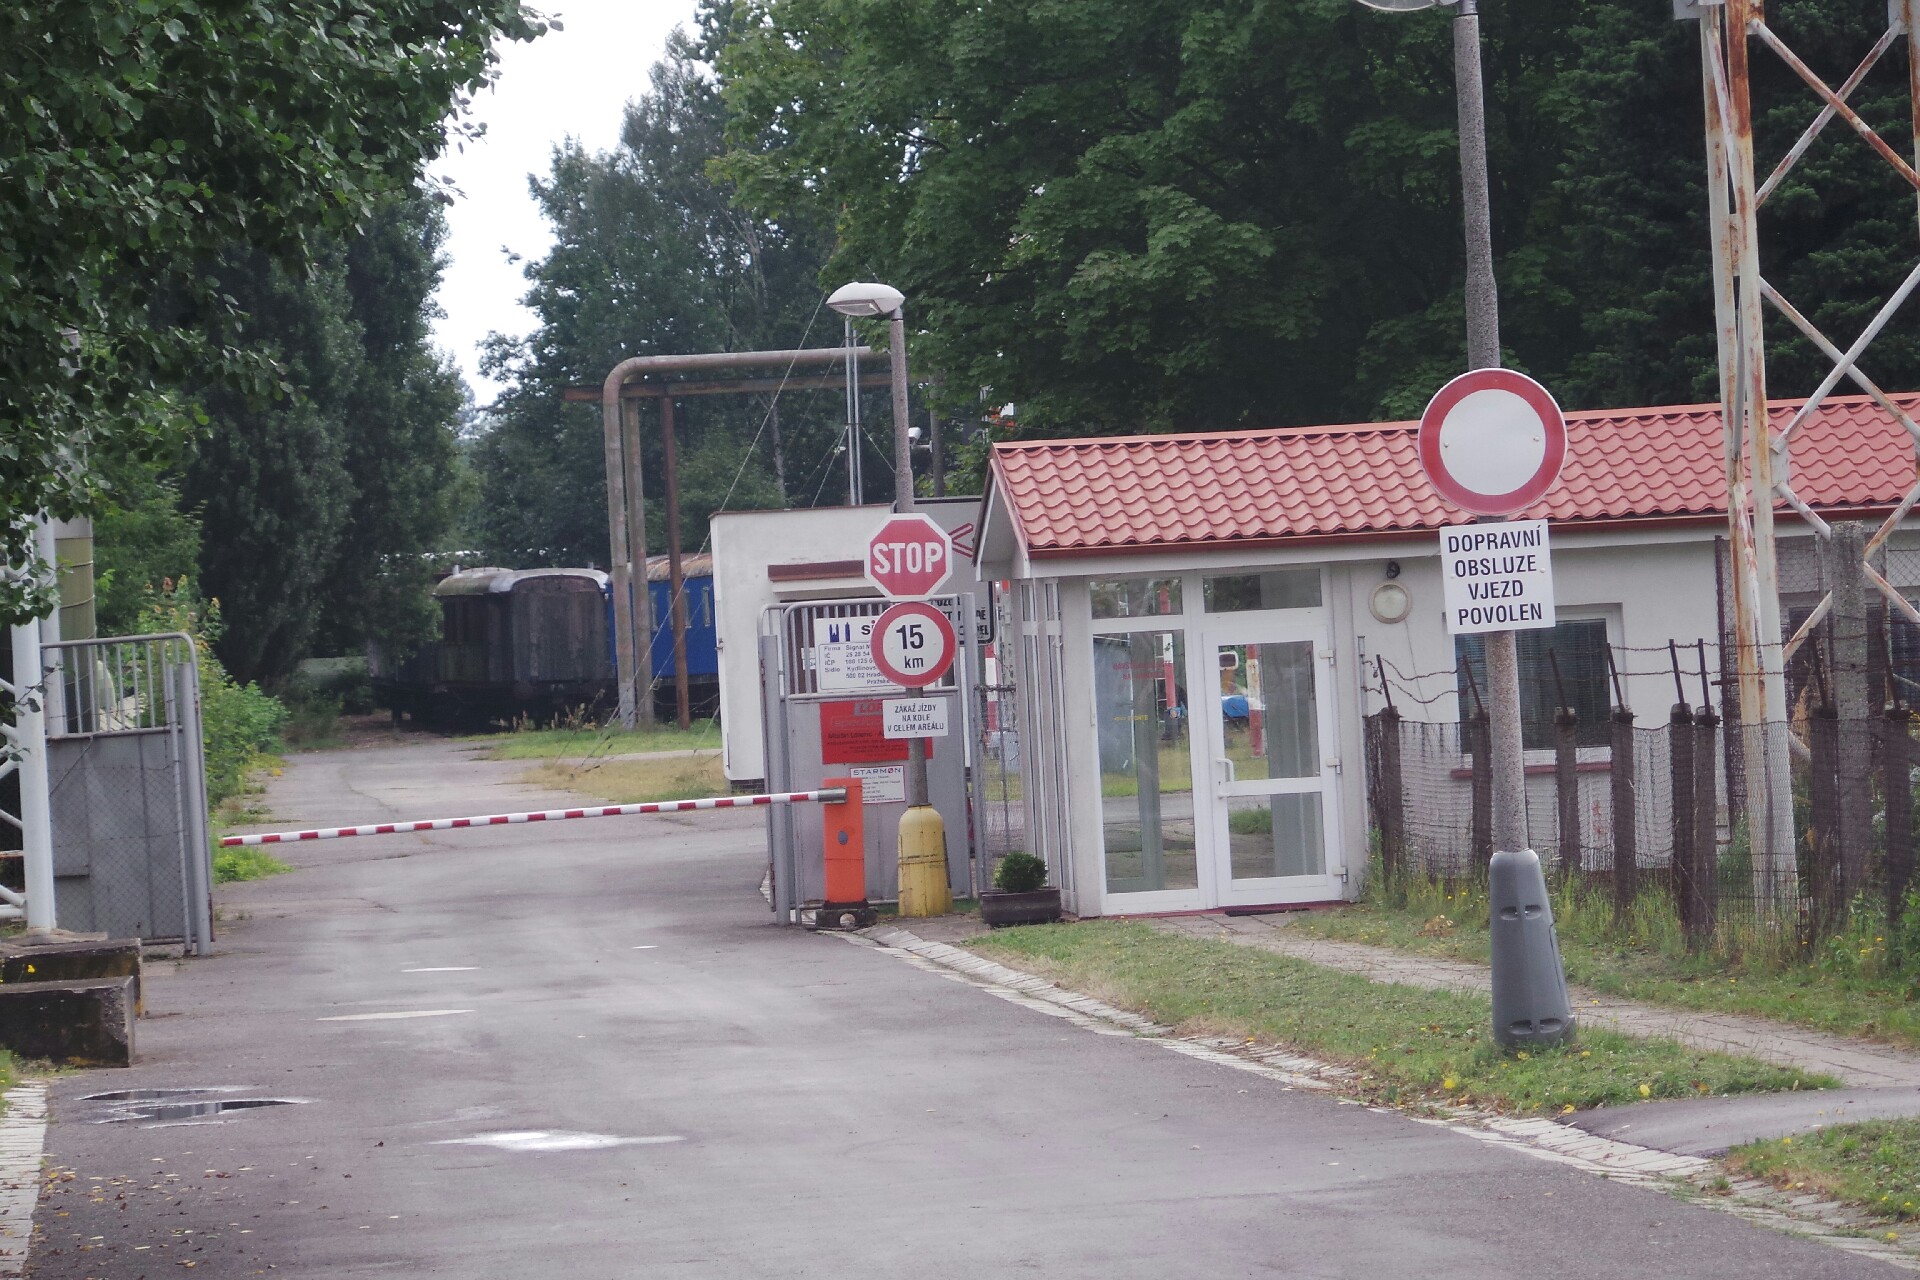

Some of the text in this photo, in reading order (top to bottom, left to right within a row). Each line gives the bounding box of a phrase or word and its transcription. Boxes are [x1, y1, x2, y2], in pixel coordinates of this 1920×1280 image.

[1448, 525, 1541, 553] DOPRAVNÍ
[872, 542, 944, 574] STOP
[1455, 555, 1537, 578] OBSLUZE
[1468, 580, 1524, 600] VJEZD
[1458, 603, 1542, 625] POVOLEN
[896, 624, 924, 650] 15
[904, 656, 924, 669] km
[917, 702, 936, 712] JÍZDY
[917, 721, 944, 730] AREÁLU
